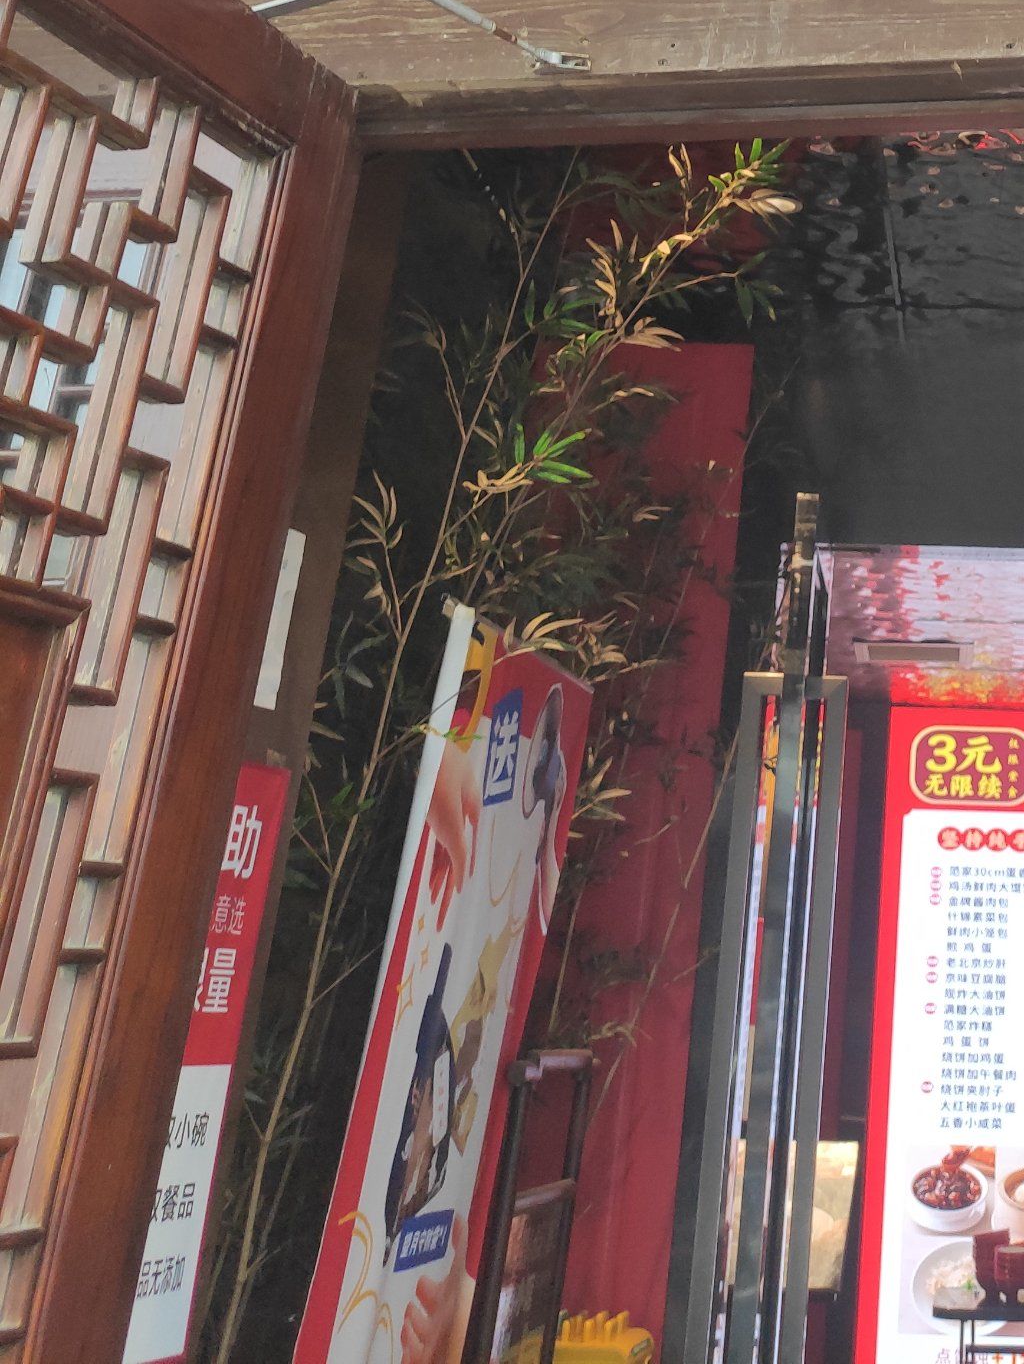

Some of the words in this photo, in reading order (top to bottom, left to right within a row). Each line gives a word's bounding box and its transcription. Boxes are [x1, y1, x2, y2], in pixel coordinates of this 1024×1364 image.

[484, 710, 520, 799] 送
[925, 733, 1002, 774] 3元
[923, 773, 1003, 799] 无限续
[221, 805, 262, 879] 助
